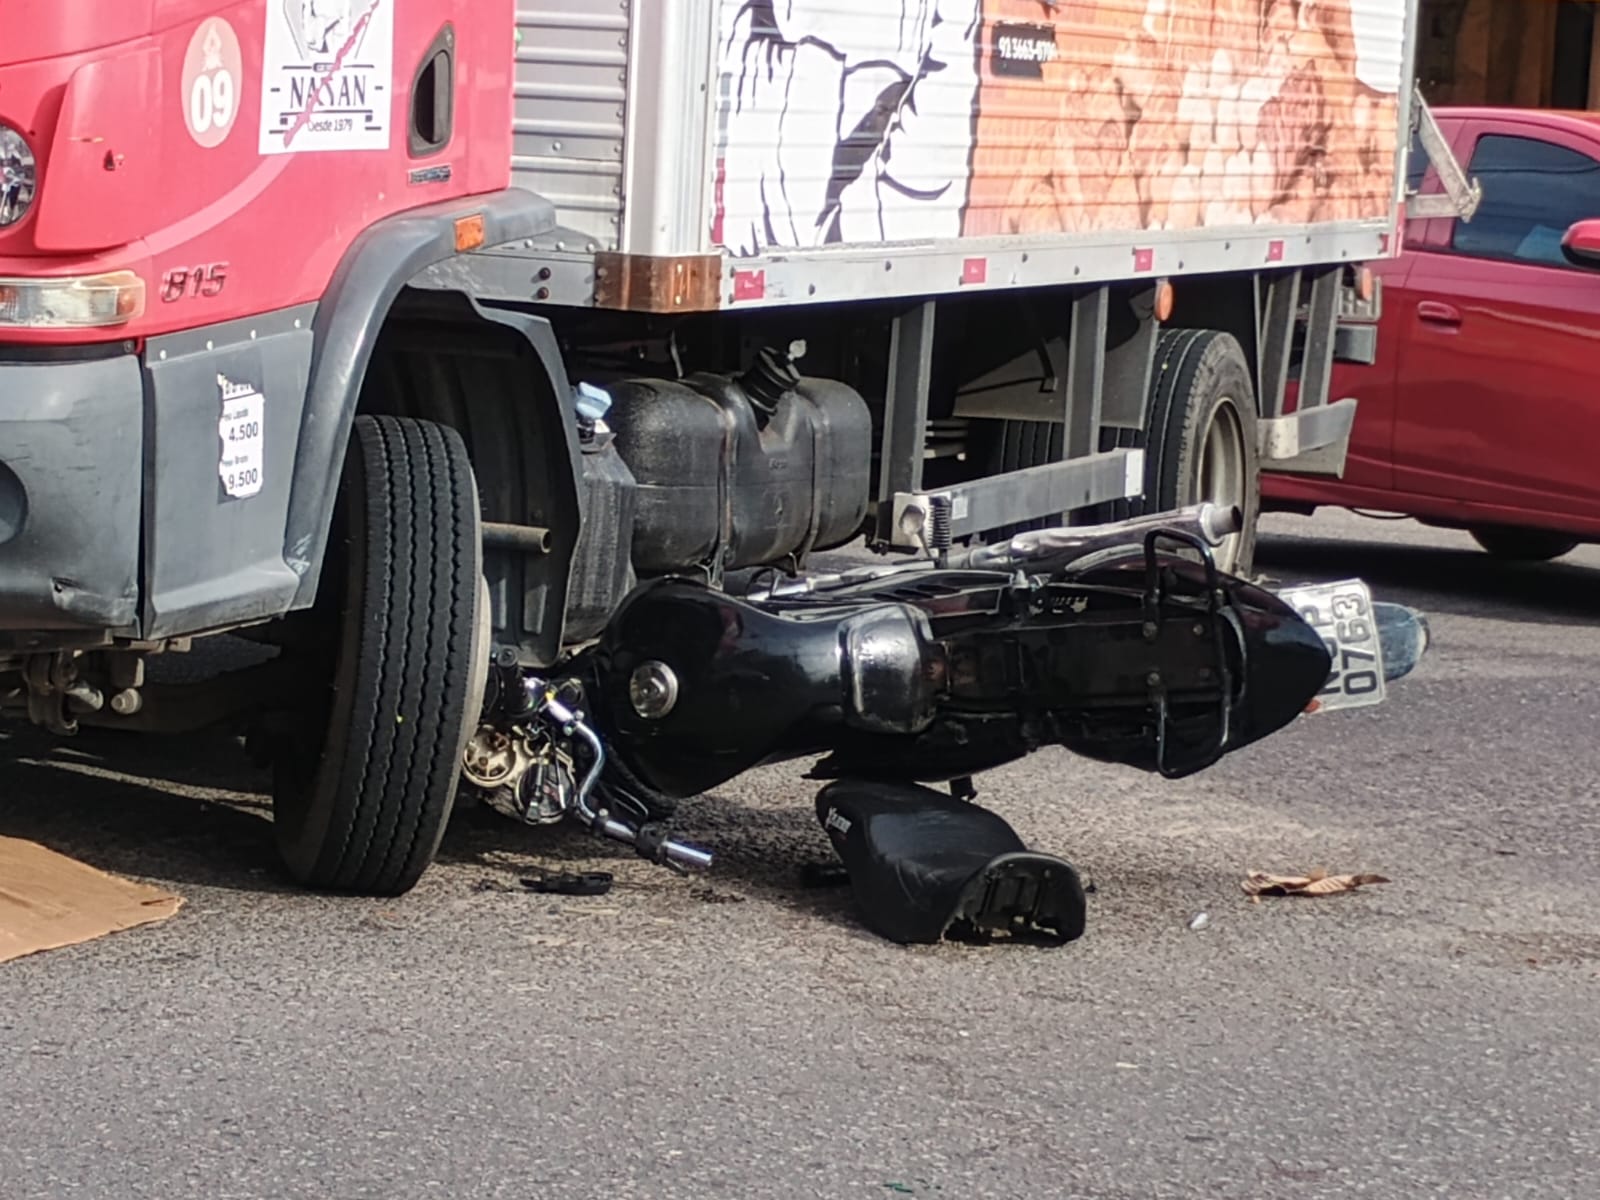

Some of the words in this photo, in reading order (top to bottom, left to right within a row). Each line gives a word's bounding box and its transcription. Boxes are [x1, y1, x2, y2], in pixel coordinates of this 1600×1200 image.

[191, 69, 234, 133] 09
[160, 261, 228, 303] 815
[228, 421, 259, 441] 4.500
[228, 467, 258, 490] 9.500
[1331, 593, 1377, 695] 0763
